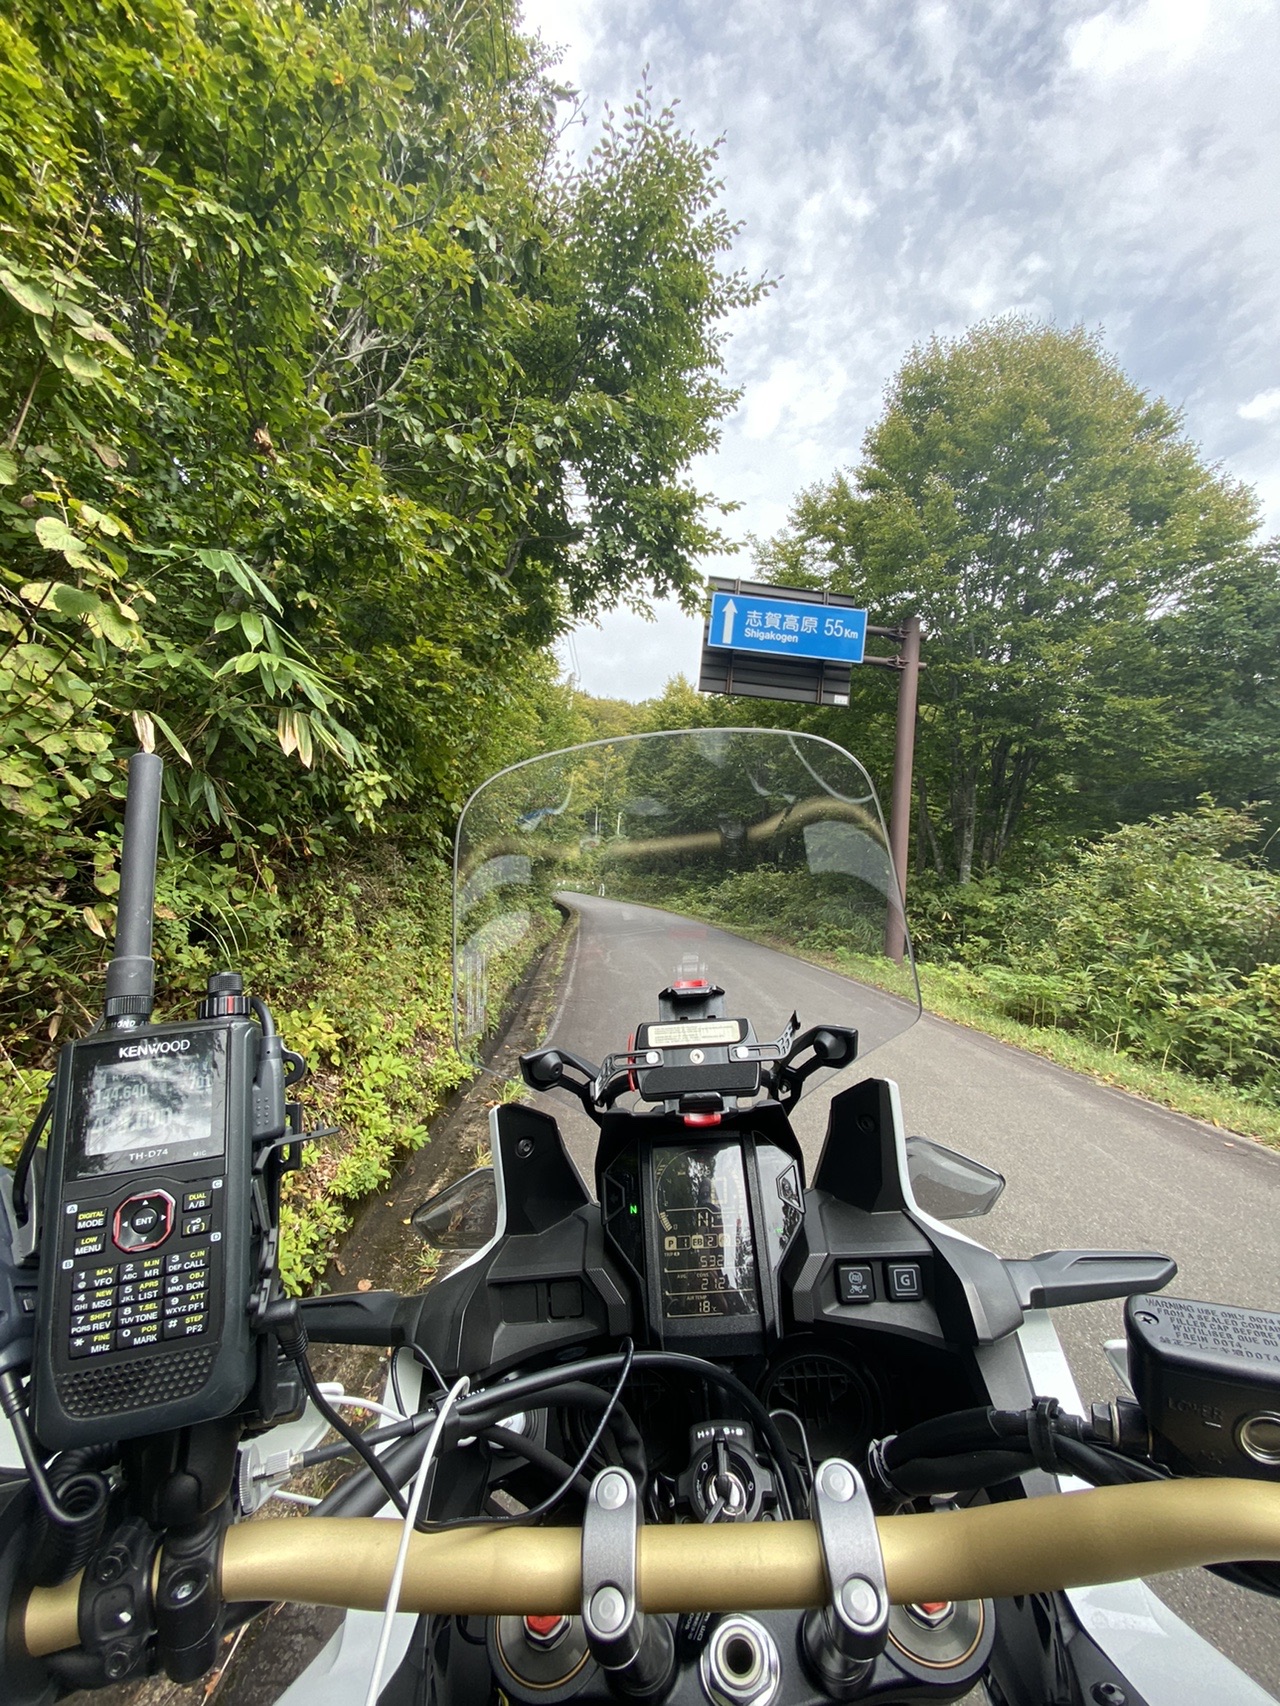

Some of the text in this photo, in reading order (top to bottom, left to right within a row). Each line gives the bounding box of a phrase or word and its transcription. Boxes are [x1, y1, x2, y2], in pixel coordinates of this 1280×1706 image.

[745, 610, 818, 634] 志賀高原
[744, 627, 799, 643] Shigakogen
[119, 1039, 191, 1058] KENWOOD
[129, 1148, 168, 1161] TH-D74
[189, 1193, 206, 1201] DUAL
[188, 1200, 205, 1209] A/B
[630, 1205, 638, 1214] N
[78, 1211, 105, 1220] DIGITAL
[77, 1218, 104, 1229] MODE
[135, 1217, 153, 1226] ENT
[81, 1236, 98, 1245] LOW
[707, 1236, 714, 1247] 2
[75, 1244, 101, 1255] MENU
[189, 1250, 205, 1258] C.IN
[125, 1263, 134, 1272] 2
[168, 1259, 206, 1272] DEF CALL
[79, 1272, 86, 1280] 1
[122, 1268, 159, 1281] ABC MR
[170, 1271, 205, 1284] 6 OBJ
[900, 1274, 911, 1286] G
[94, 1277, 113, 1287] VFO
[124, 1280, 159, 1294] 5 APRS
[167, 1280, 205, 1293] MNO BCN
[77, 1289, 113, 1302] 4 NEW
[121, 1290, 159, 1303] JKL LIST
[171, 1292, 205, 1305] 9 ATT
[74, 1299, 112, 1311] GHI MSG
[123, 1306, 132, 1315] 8
[166, 1302, 204, 1315] WXYZ PF1
[1145, 1298, 1195, 1313] WARNING
[1220, 1311, 1245, 1320] ONLY
[1249, 1315, 1275, 1325] DOT4
[1157, 1307, 1185, 1318] FROM
[1188, 1312, 1195, 1320] A
[76, 1311, 112, 1324] 7 SHIFT
[135, 1312, 158, 1323] TONE
[185, 1314, 204, 1324] STEP
[92, 1321, 112, 1331] REV
[141, 1325, 157, 1333] POS
[186, 1324, 203, 1335] PF2
[1169, 1316, 1208, 1329] FILLER
[1210, 1323, 1229, 1332] CAP
[1232, 1327, 1276, 1340] BEFORE
[93, 1332, 111, 1342] FINE
[133, 1334, 157, 1345] MARK
[91, 1344, 110, 1353] MHz
